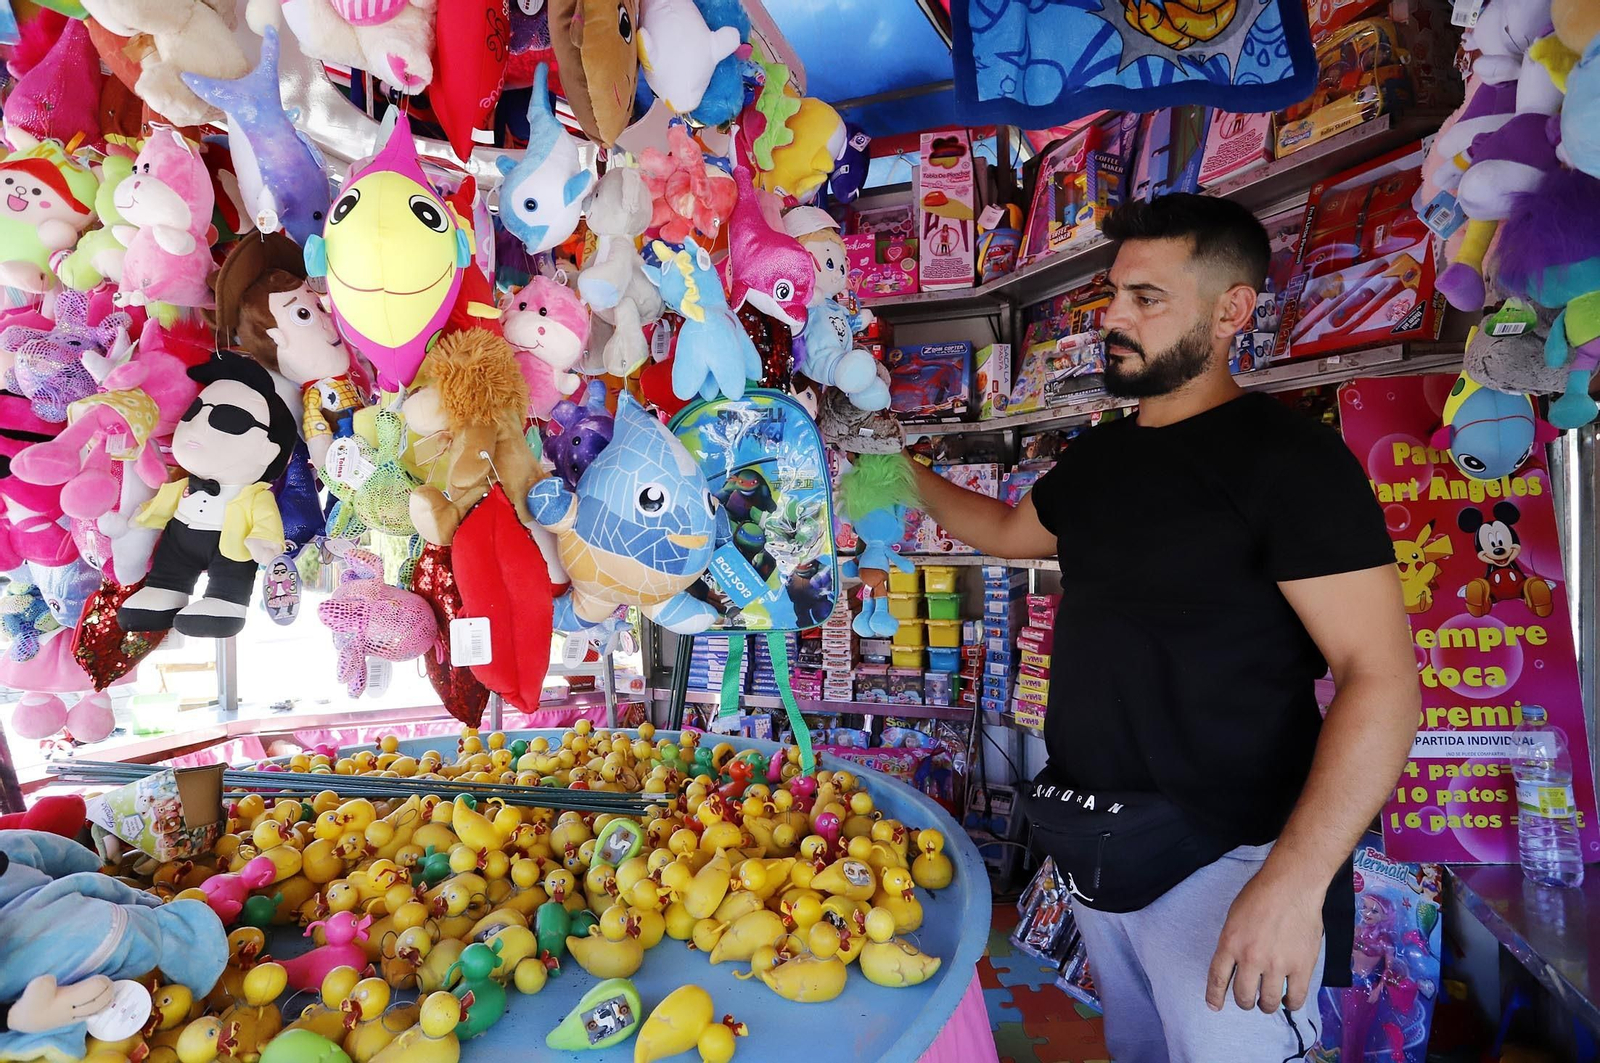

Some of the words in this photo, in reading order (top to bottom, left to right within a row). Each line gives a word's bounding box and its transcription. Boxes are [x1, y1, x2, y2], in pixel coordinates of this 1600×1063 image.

[1094, 155, 1119, 165] COFFEE
[1101, 163, 1124, 174] MAKER
[843, 238, 872, 250] ashion
[1003, 371, 1010, 383] LA
[337, 457, 346, 477] Toinsa
[1428, 475, 1542, 503] Angeles
[1409, 625, 1548, 652] iempre
[1420, 665, 1507, 688] toca
[1415, 736, 1464, 746] PARTIDA
[1403, 761, 1420, 777] 4
[1397, 787, 1428, 803] 10
[1436, 786, 1509, 806] patos
[1390, 812, 1422, 828] 16
[1429, 812, 1503, 831] patos
